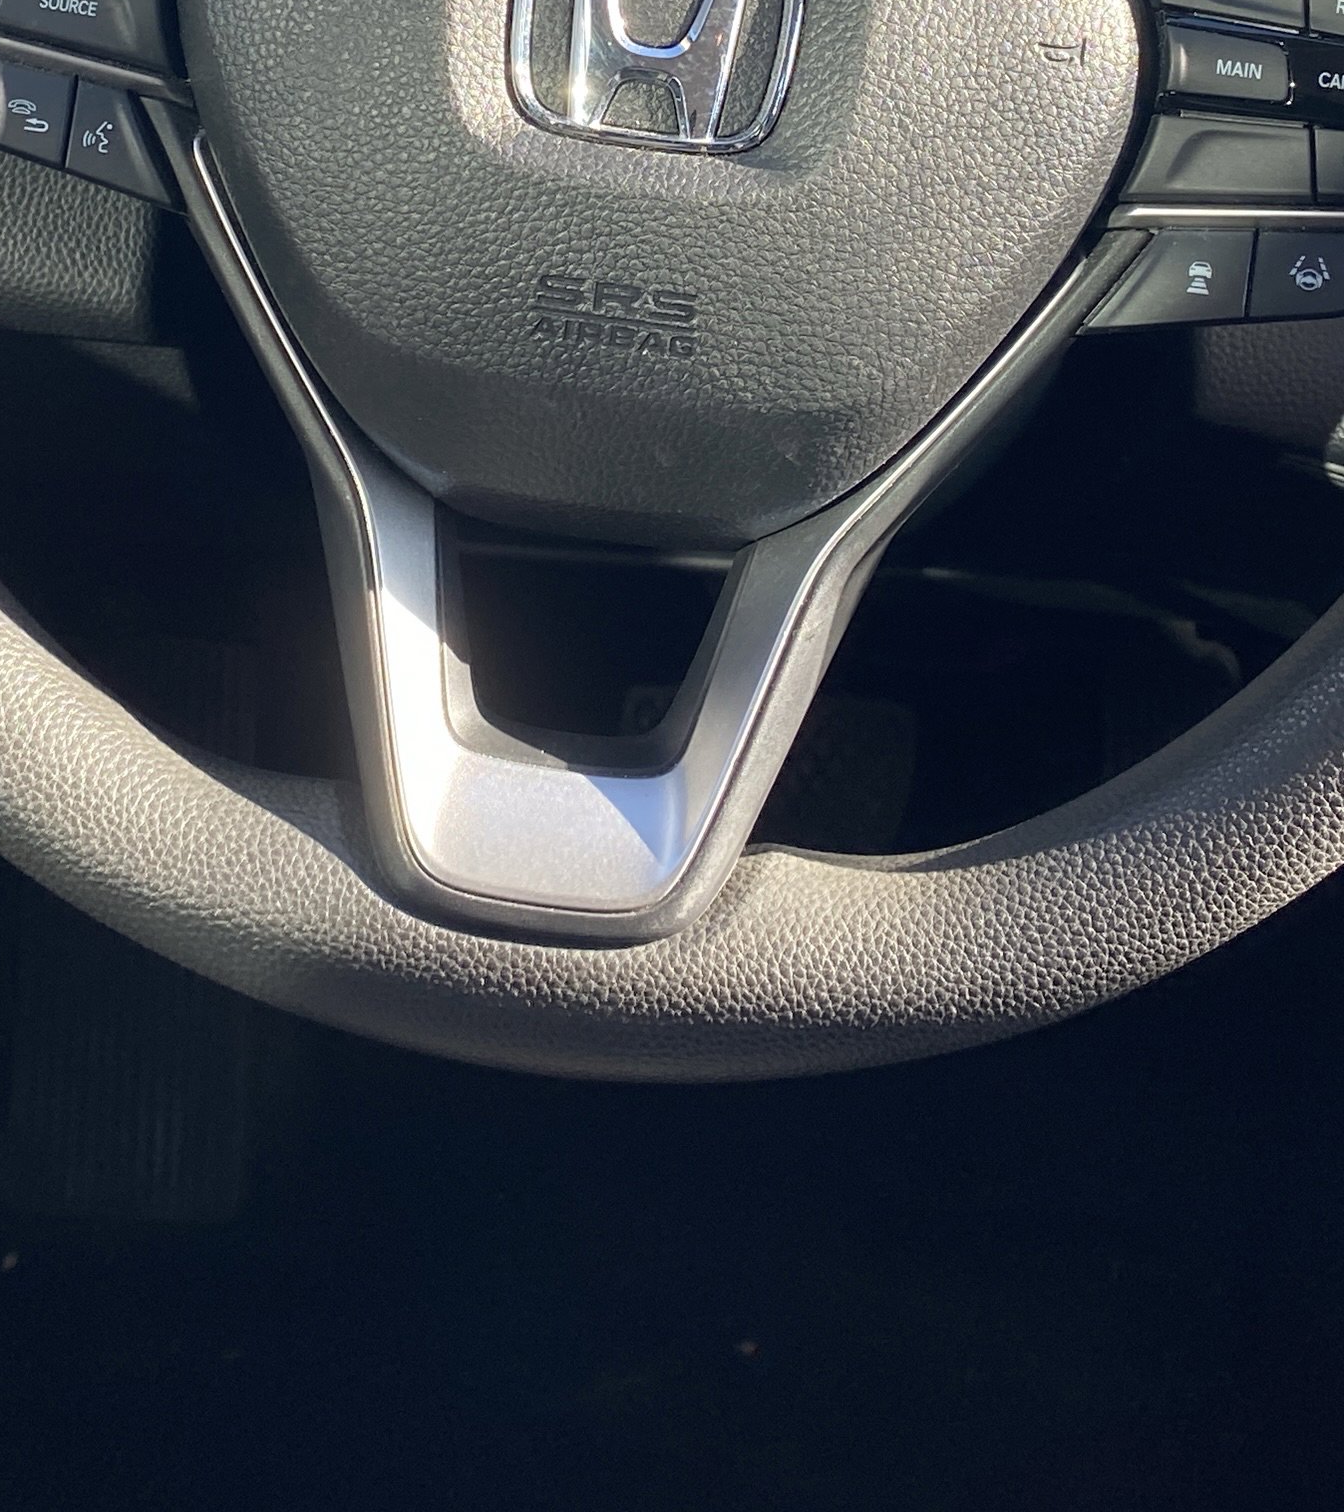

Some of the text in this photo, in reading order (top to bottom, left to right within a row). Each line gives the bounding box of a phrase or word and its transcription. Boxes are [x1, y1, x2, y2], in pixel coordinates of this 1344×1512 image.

[1216, 59, 1263, 80] MAIN
[536, 274, 698, 319] SRS
[529, 317, 699, 358] AIRBAG
